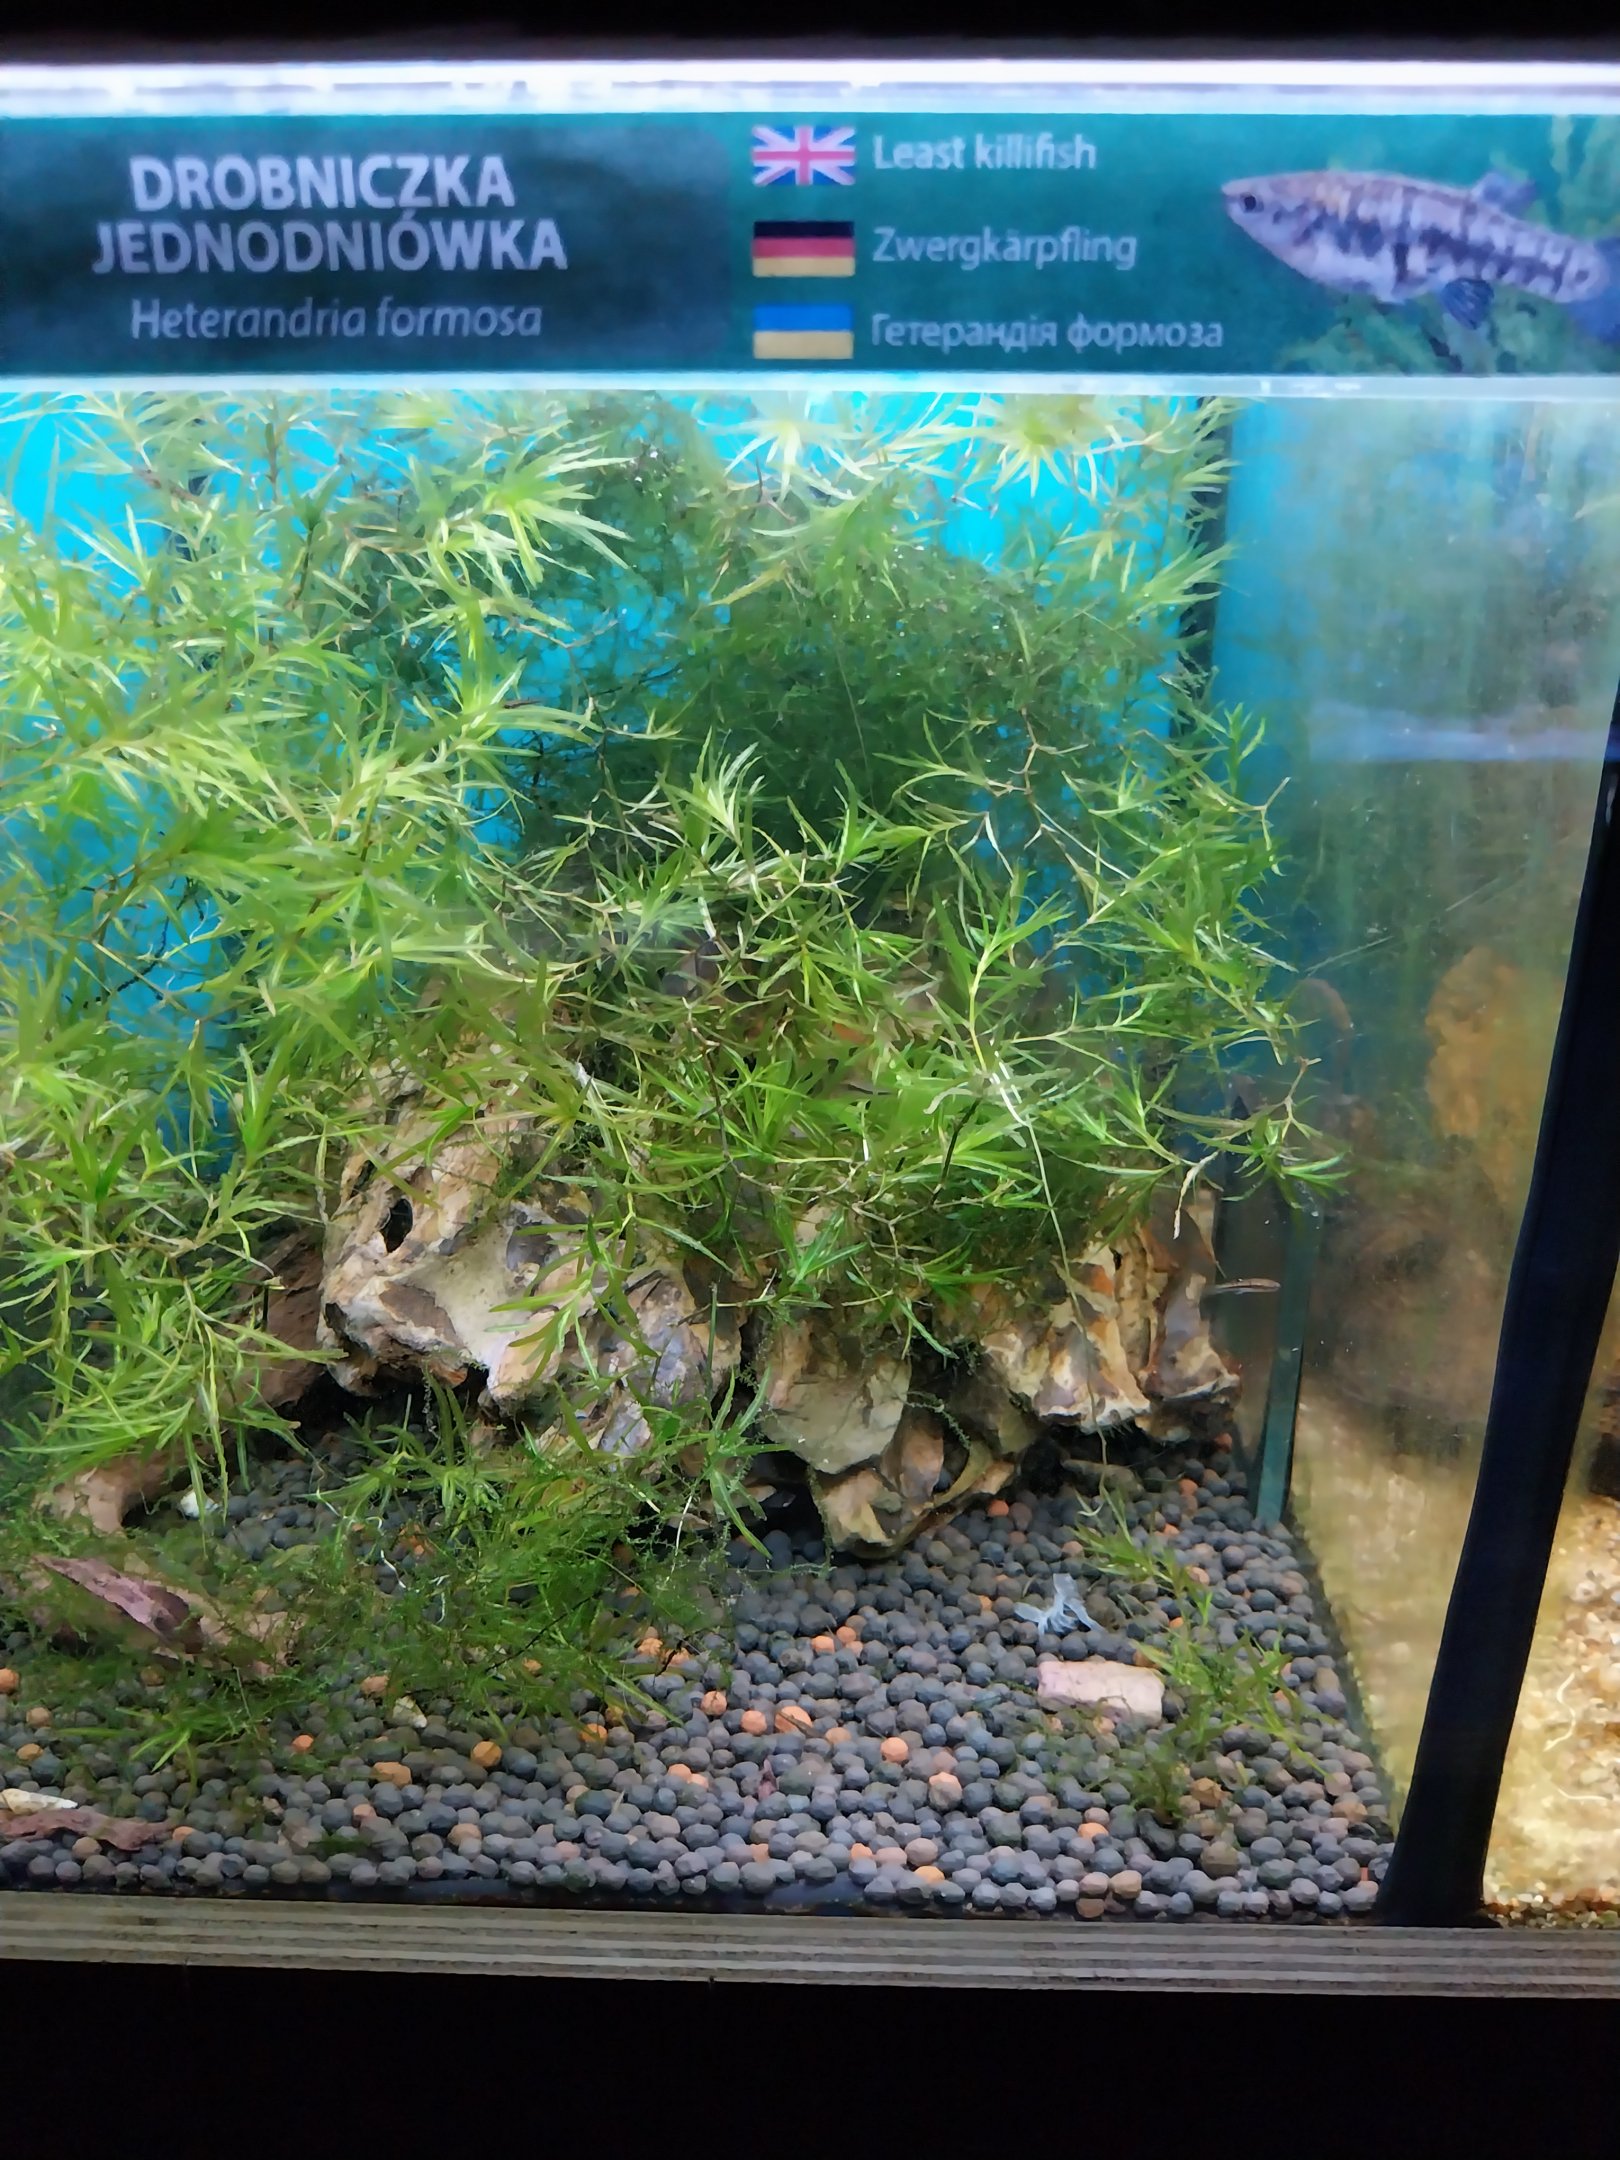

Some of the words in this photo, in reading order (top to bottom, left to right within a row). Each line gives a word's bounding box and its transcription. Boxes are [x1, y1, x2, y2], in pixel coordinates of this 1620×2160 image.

[873, 134, 966, 170] Least
[974, 132, 1098, 171] killifish
[129, 154, 515, 212] DROBNICZKA
[92, 208, 568, 274] JEDNODNIÓWKA
[130, 298, 366, 338] Heterandria
[376, 297, 543, 337] formosa
[1066, 313, 1224, 354] формоза
